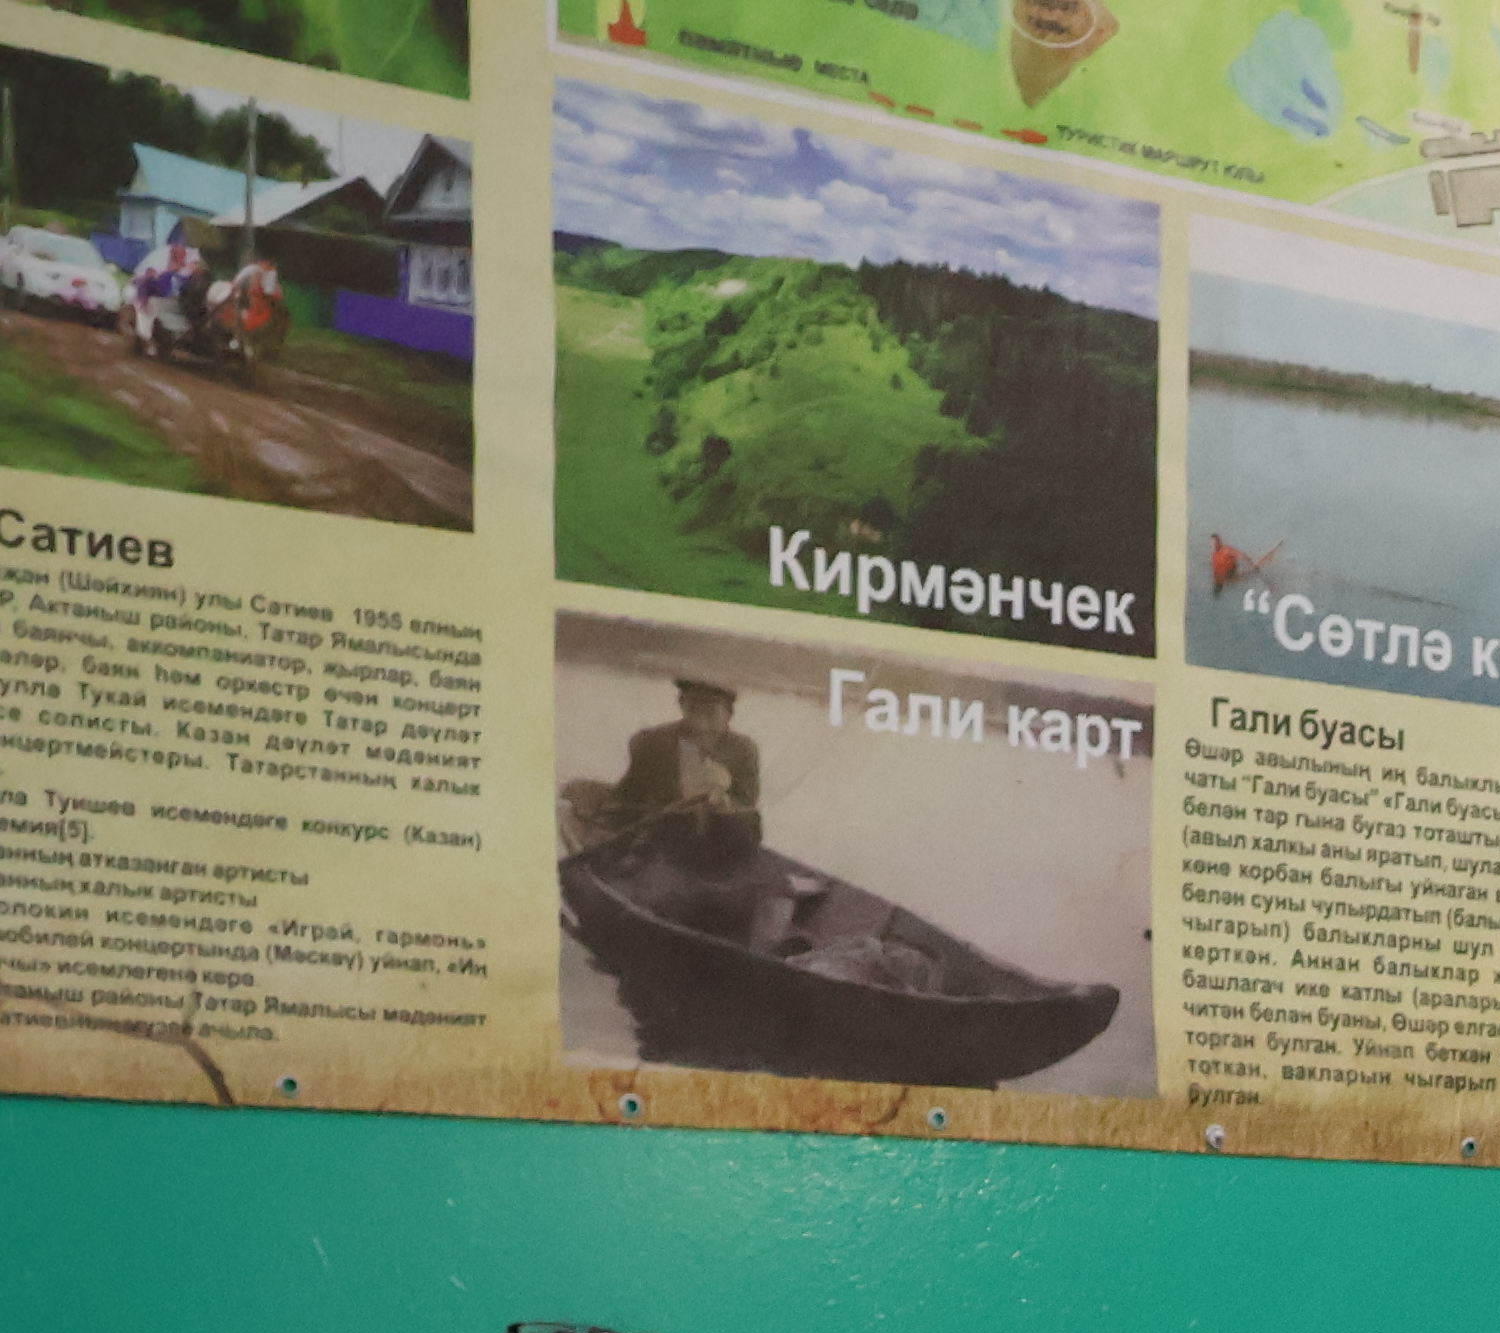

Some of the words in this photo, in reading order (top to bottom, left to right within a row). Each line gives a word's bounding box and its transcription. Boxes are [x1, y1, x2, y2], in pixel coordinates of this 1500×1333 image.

[768, 525, 1136, 636] Кирмәнчек
[1241, 589, 1453, 672] “Сөтлә
[828, 667, 985, 743] Гали
[1007, 704, 1143, 770] карт
[1211, 697, 1291, 738] Гали
[1299, 708, 1405, 751] буасы
